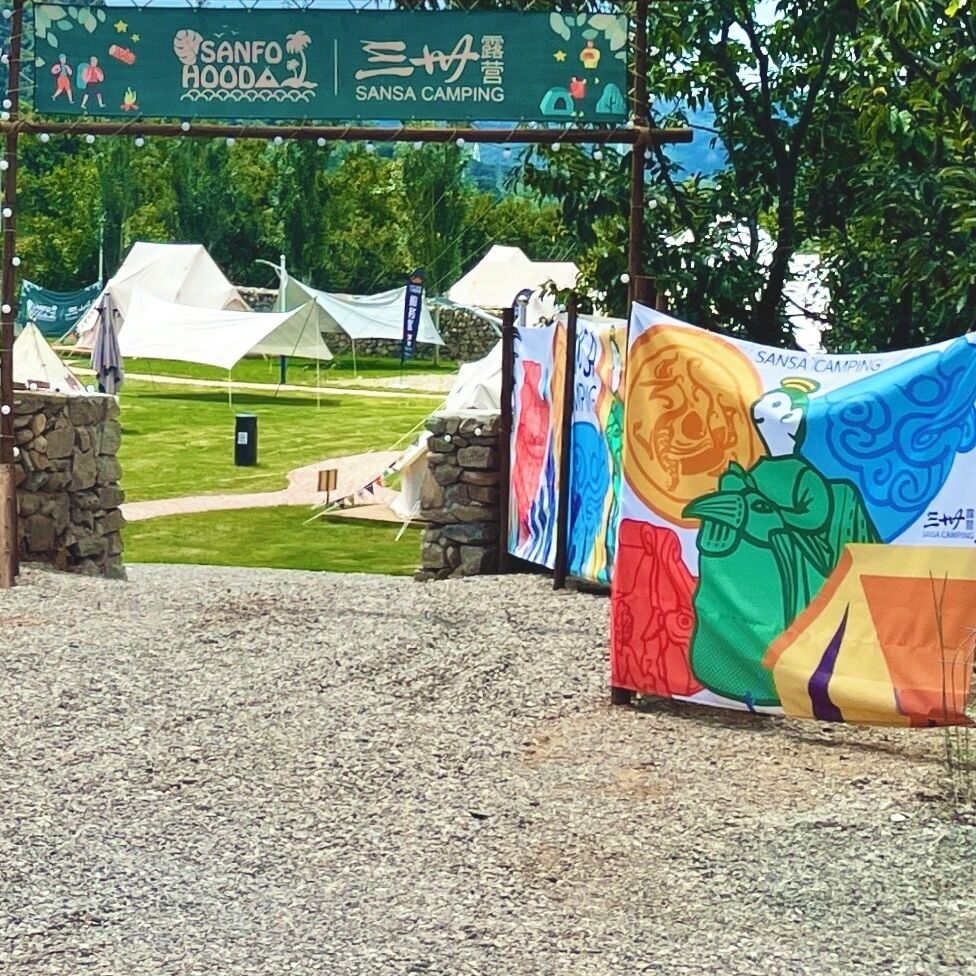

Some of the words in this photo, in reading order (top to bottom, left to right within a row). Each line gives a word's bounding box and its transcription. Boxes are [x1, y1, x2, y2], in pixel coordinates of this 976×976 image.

[200, 39, 283, 64] SANFO
[355, 85, 417, 101] SANSA
[421, 85, 505, 102] CAMPING
[755, 350, 808, 370] SANSA
[813, 358, 883, 375] CAMPING
